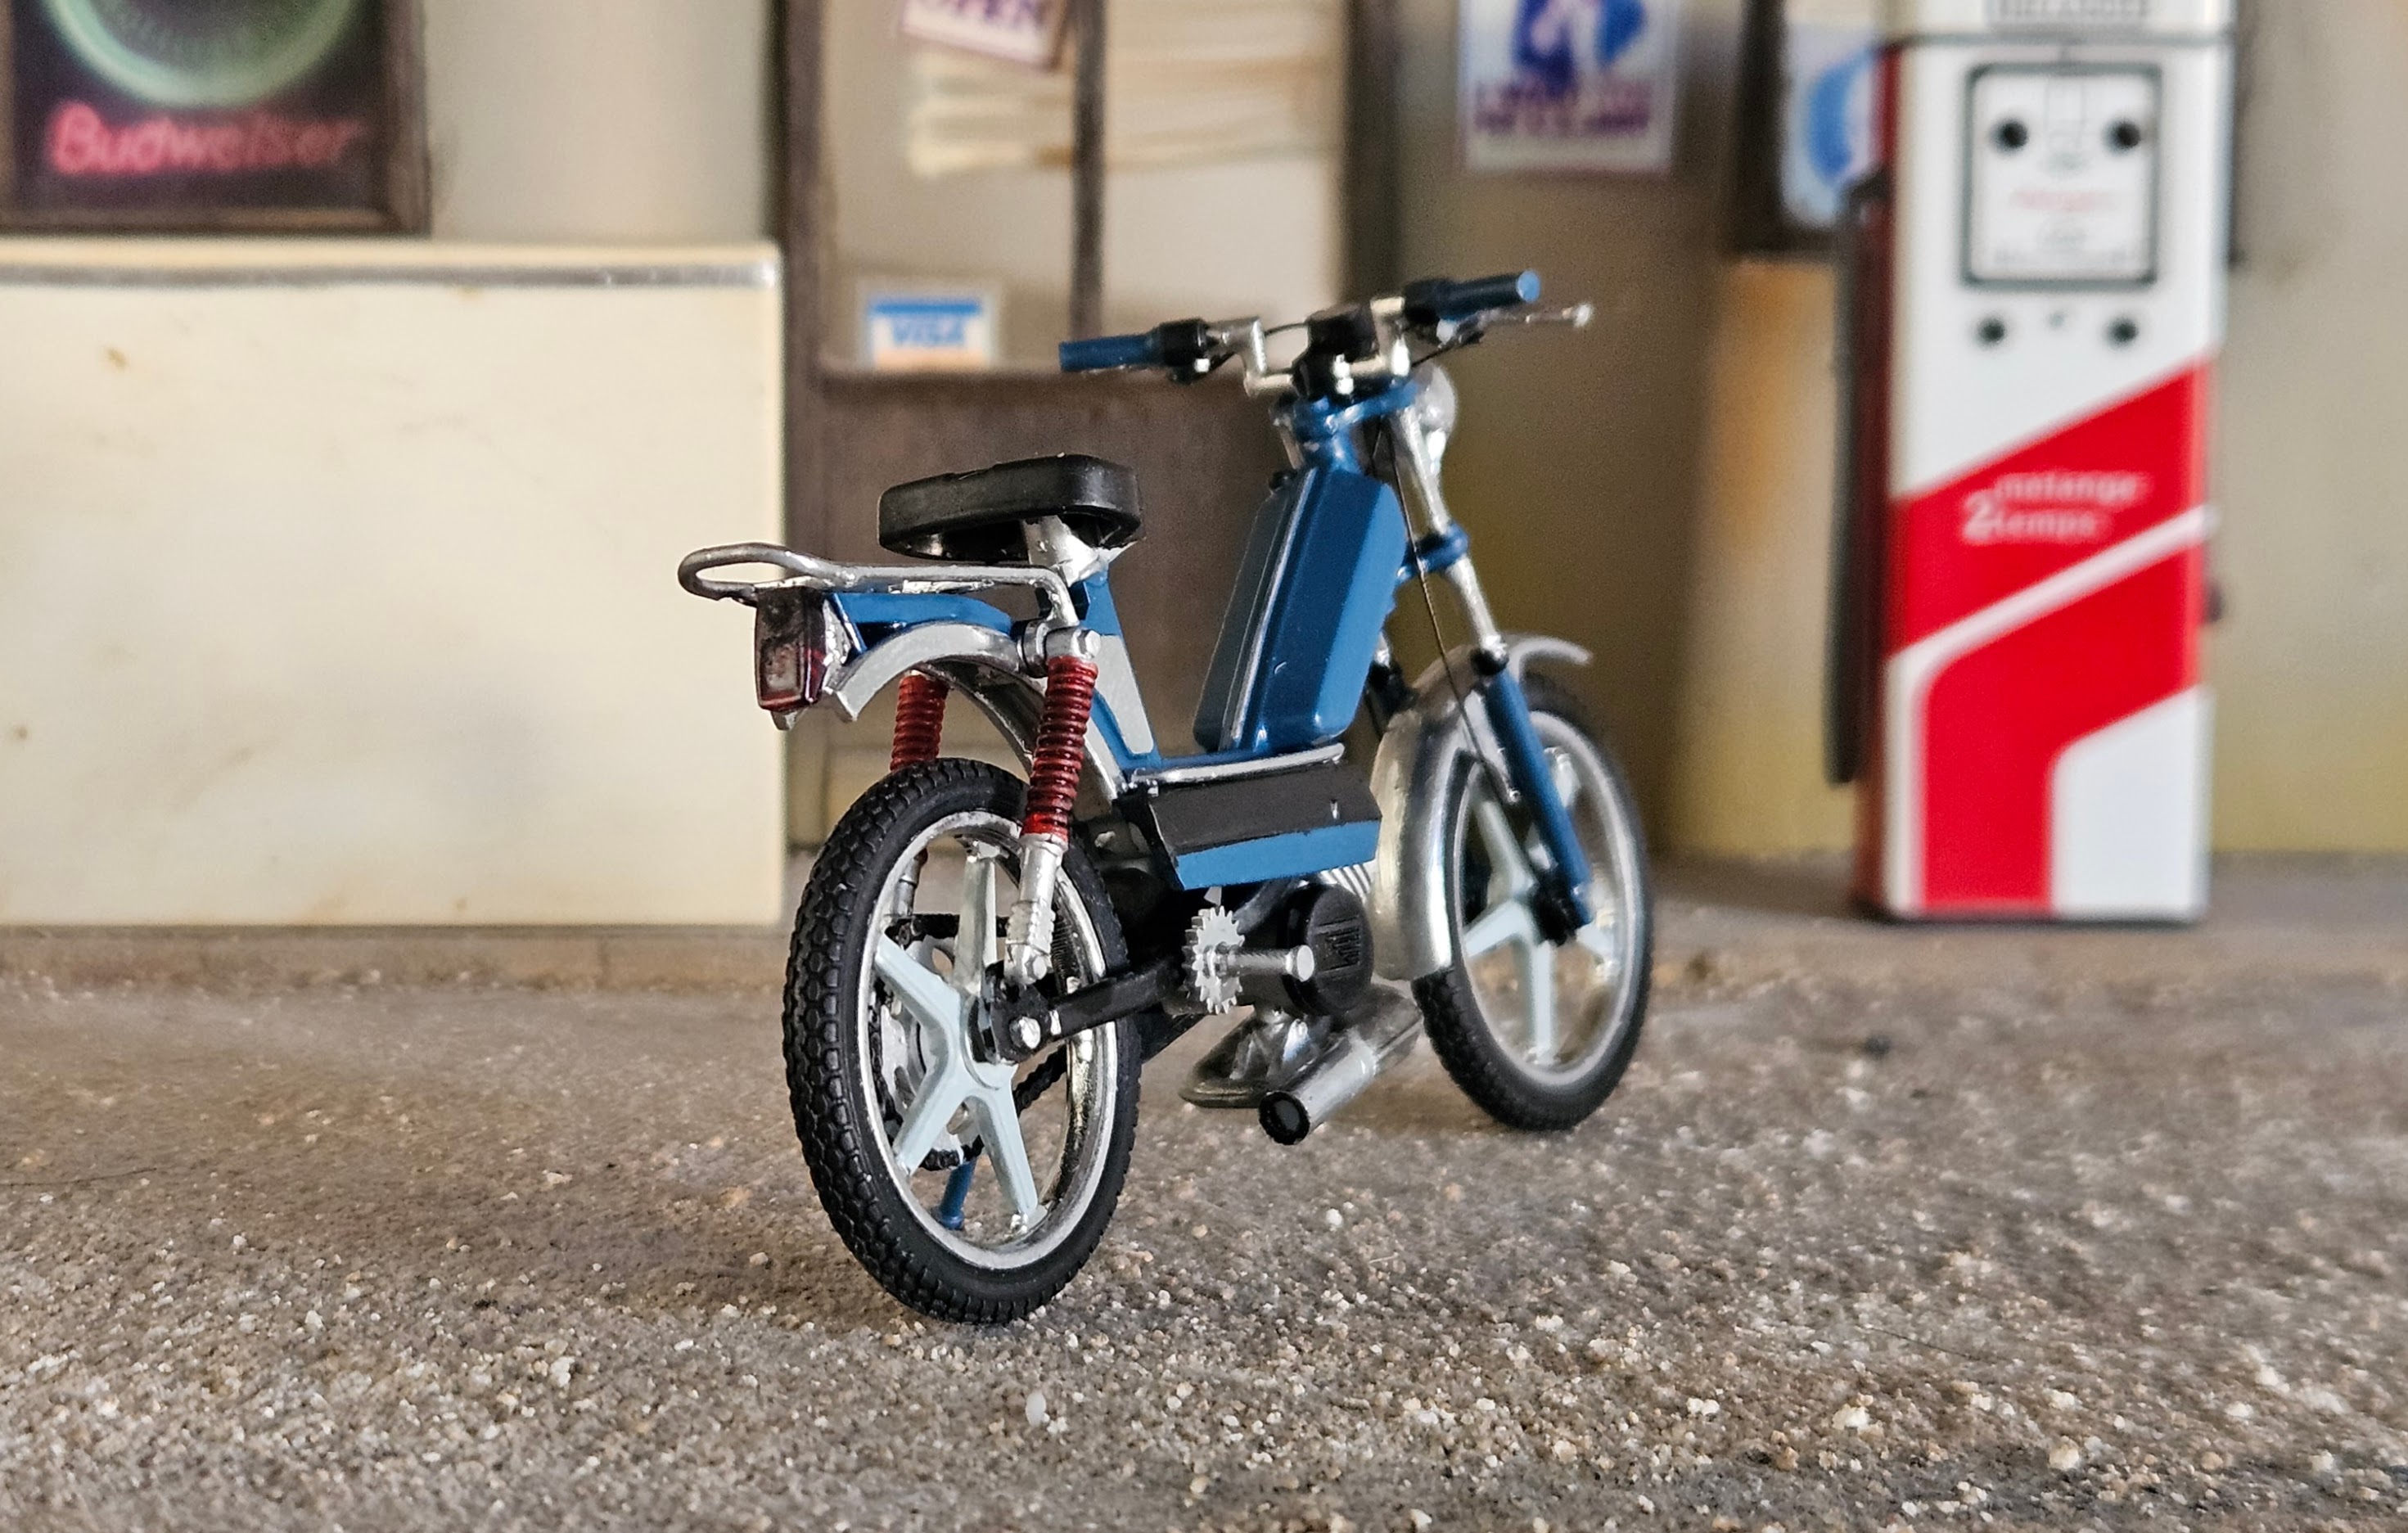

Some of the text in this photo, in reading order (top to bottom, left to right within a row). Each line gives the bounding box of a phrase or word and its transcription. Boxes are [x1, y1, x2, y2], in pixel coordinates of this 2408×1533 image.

[51, 101, 362, 174] Budweiser
[891, 318, 966, 347] VISA
[1963, 490, 1997, 542] 2
